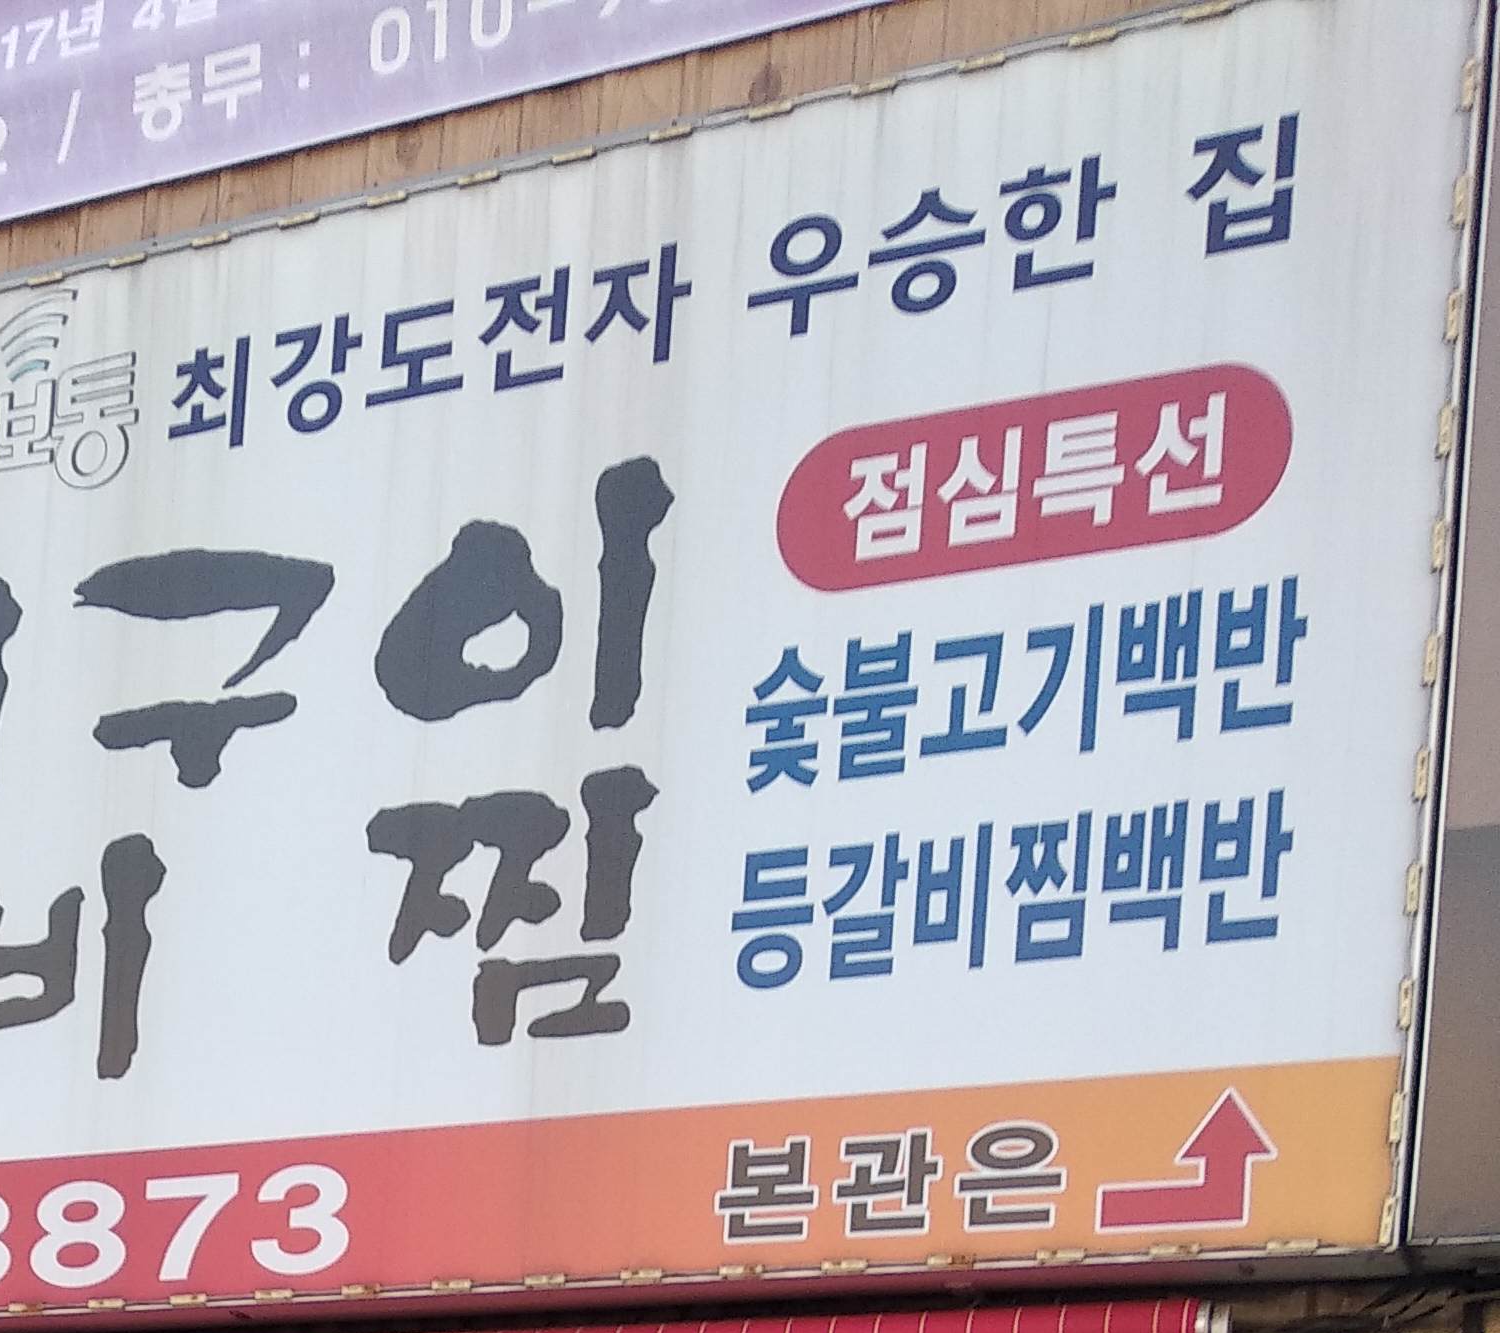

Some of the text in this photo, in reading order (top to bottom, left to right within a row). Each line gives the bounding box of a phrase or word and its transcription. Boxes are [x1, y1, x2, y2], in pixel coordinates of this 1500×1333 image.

[132, 43, 264, 143] 총무
[168, 111, 1301, 448] 최강도전자 우승한 집
[842, 391, 1228, 564] 점심특선
[744, 575, 1308, 795] 숯불고기백반
[731, 788, 1295, 990] 등갈비찜백반
[715, 1120, 1066, 1246] 본관은
